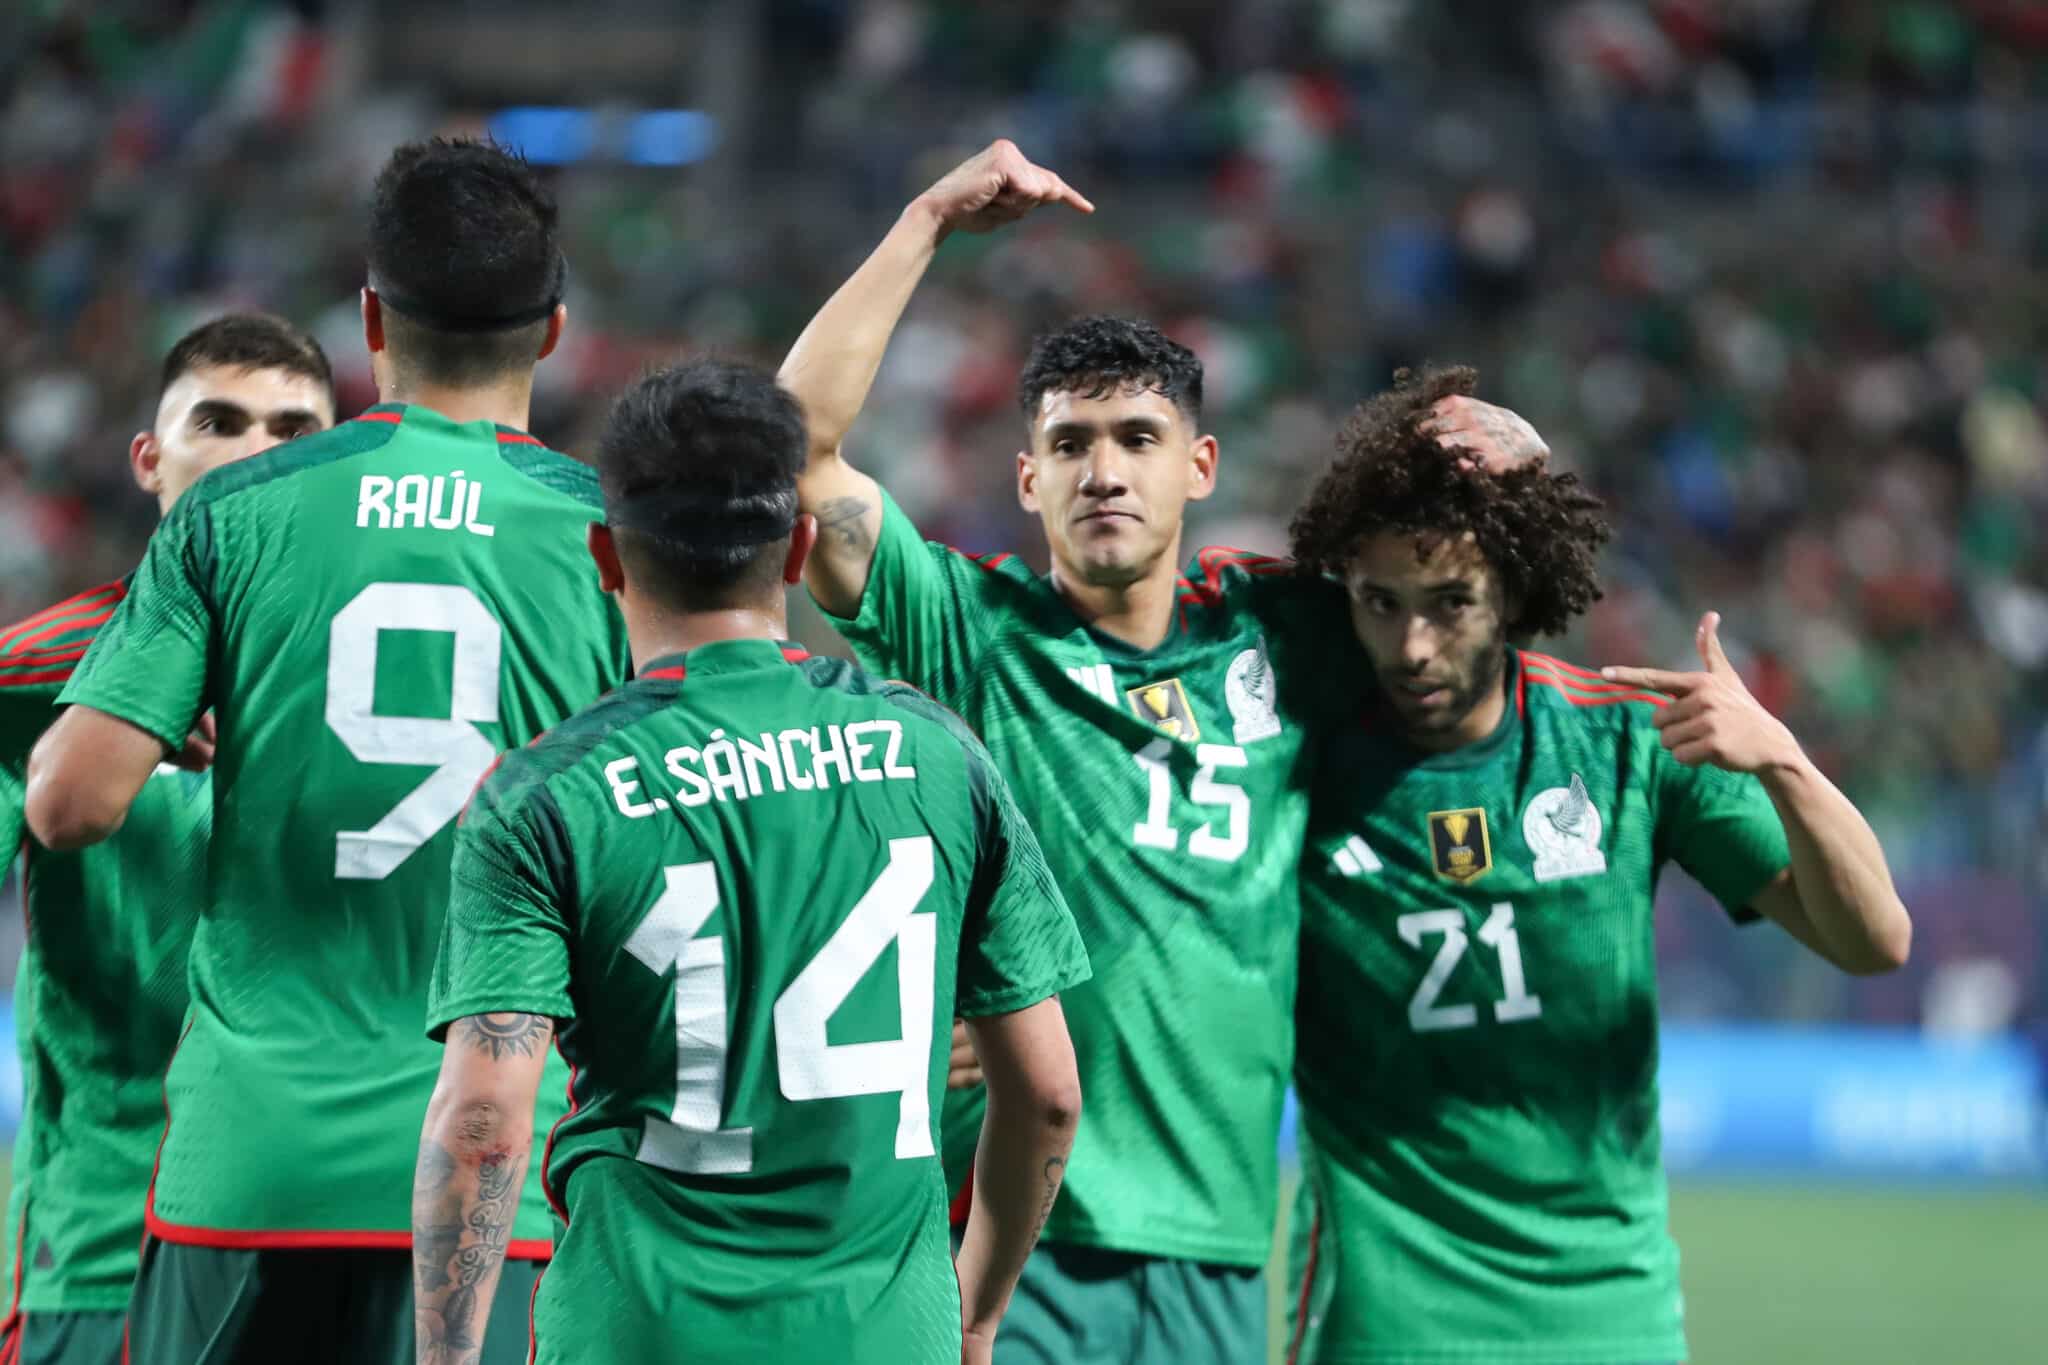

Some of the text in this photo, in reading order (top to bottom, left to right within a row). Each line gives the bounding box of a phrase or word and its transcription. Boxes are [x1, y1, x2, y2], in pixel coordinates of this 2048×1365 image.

[356, 470, 495, 537] RAÚL
[324, 582, 501, 880] 9
[1133, 737, 1251, 863] 15
[622, 835, 937, 1175] 14
[1397, 901, 1543, 1032] 21
